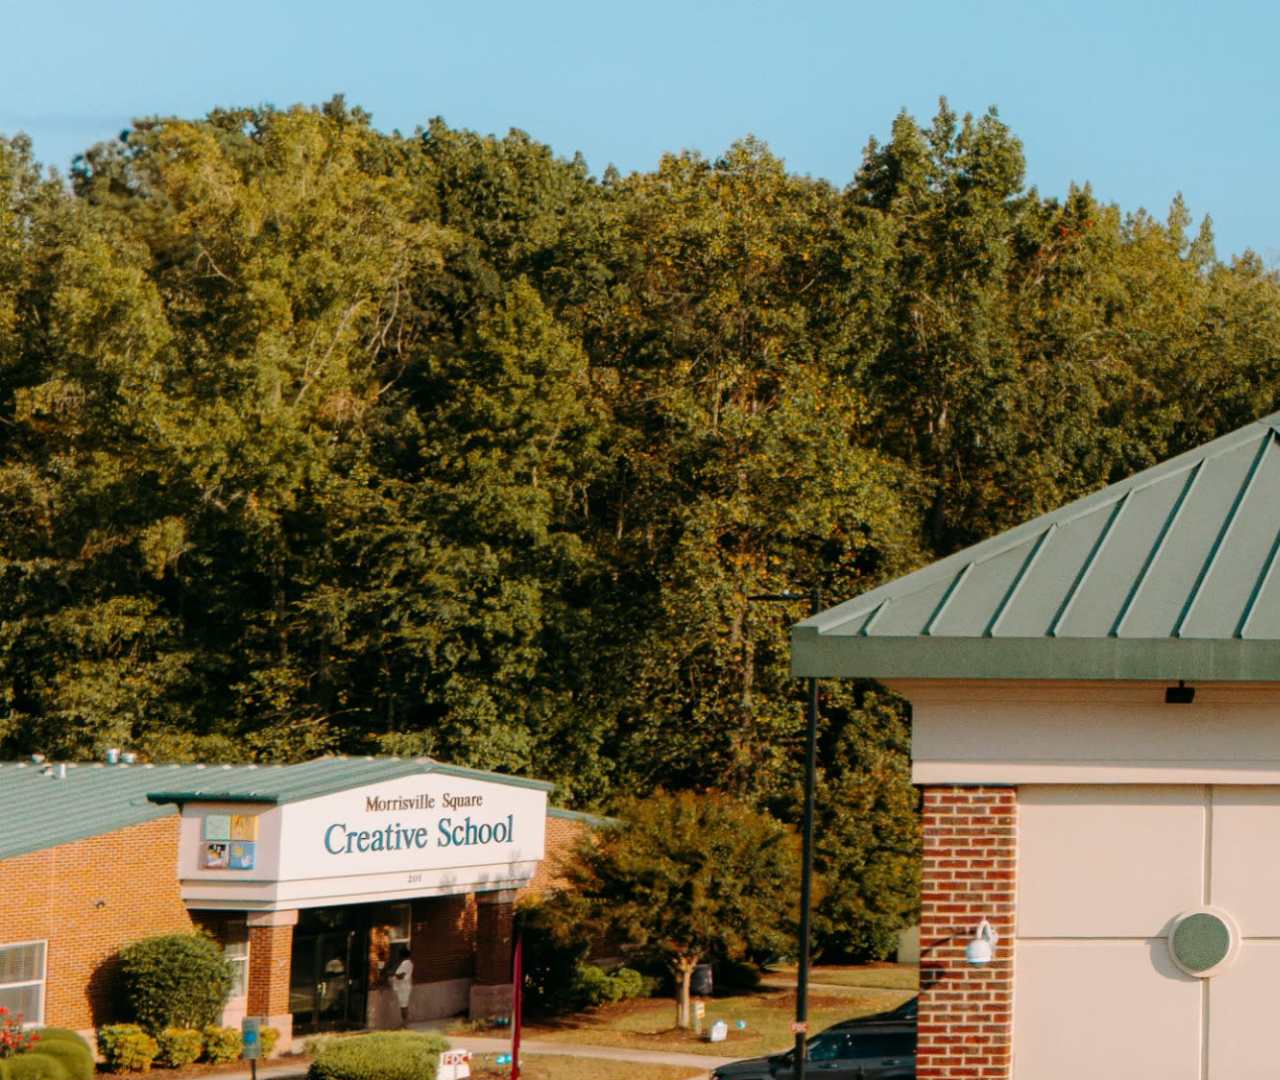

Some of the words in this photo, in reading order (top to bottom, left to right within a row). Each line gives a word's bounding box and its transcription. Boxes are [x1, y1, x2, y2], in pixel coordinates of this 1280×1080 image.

[366, 794, 435, 812] Morrisville
[442, 793, 483, 811] Square
[324, 822, 428, 855] Creative
[437, 814, 514, 848] School
